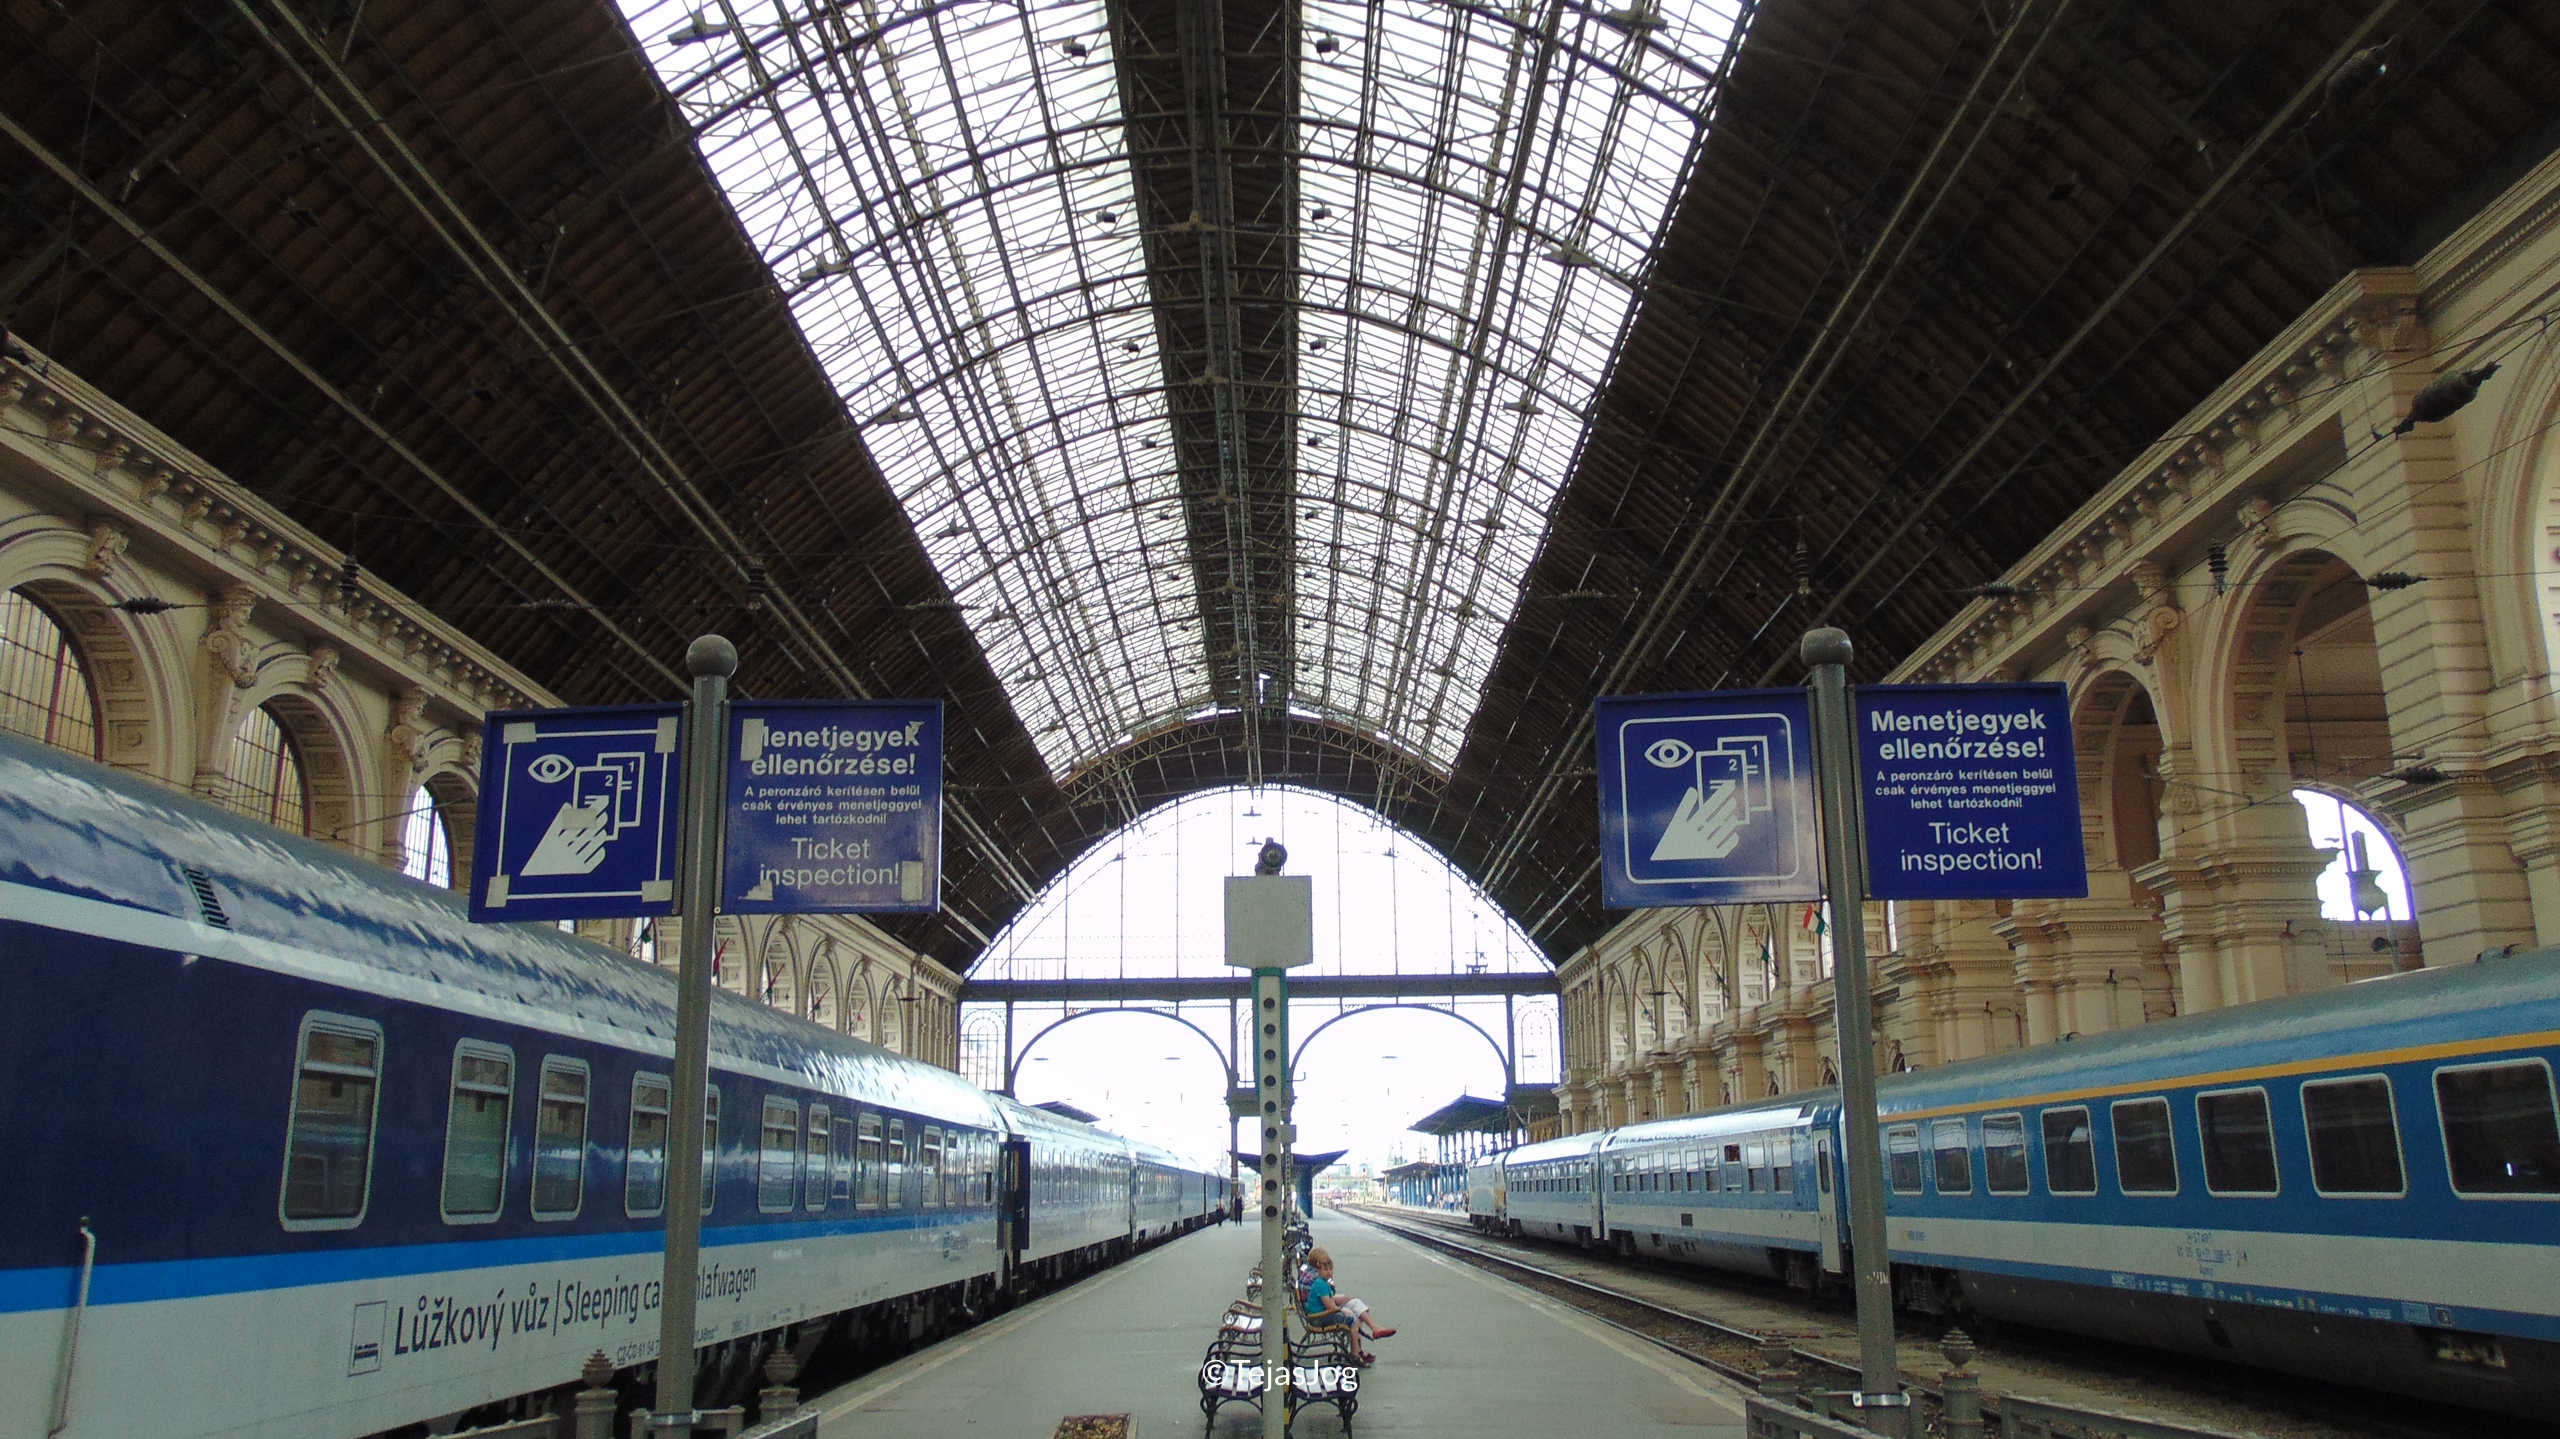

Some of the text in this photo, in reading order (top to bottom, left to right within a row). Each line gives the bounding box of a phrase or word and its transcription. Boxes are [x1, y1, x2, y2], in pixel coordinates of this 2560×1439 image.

[1871, 708, 2047, 736] Menetjegyek
[1879, 736, 2046, 760] ellenőrzése!
[751, 753, 916, 776] ellenőrzése!
[1876, 771, 1886, 782] A
[1891, 769, 1954, 784] peronzáró
[1959, 769, 2018, 780] kerítésen
[745, 786, 754, 797] A
[759, 785, 822, 800] peronzáró
[827, 785, 886, 797] kerítésen
[1875, 782, 2056, 798] csak érvényes menetjeggyel
[742, 798, 922, 814] csak érvényes menetjeggyel
[1911, 796, 2023, 809] lehet tartózkodni!
[776, 813, 887, 825] lehet tartózkodni!
[1928, 821, 2010, 844] Ticket
[791, 837, 870, 860] Ticket
[1900, 847, 2043, 875] inspection!
[760, 862, 899, 890] inspection!
[394, 1288, 505, 1356] Lůžkový
[512, 1281, 550, 1334] vůz
[563, 1275, 640, 1330] Sleeping
